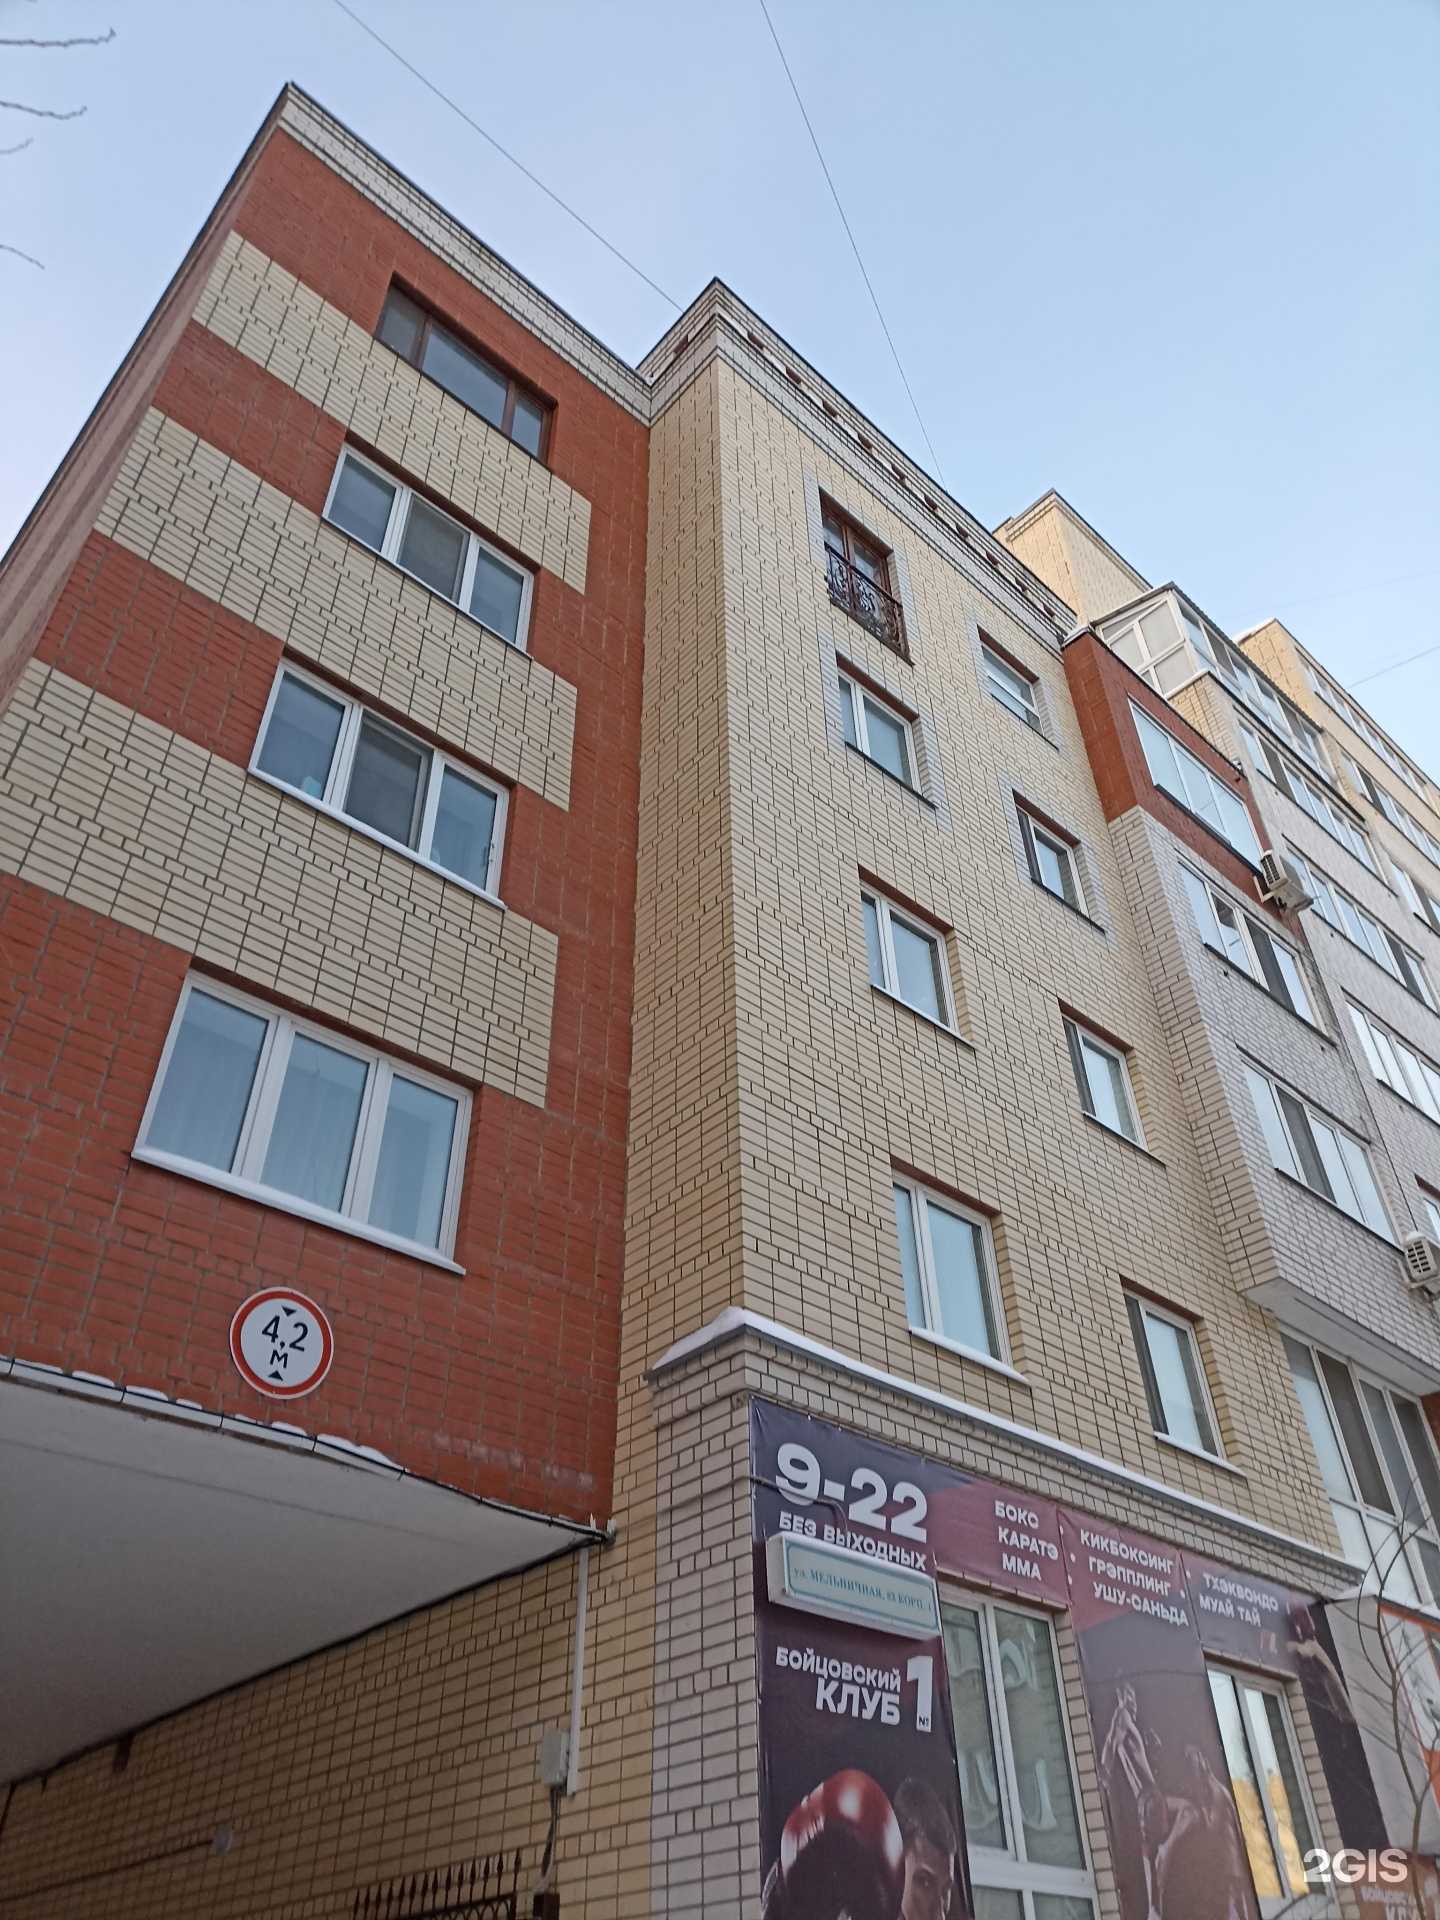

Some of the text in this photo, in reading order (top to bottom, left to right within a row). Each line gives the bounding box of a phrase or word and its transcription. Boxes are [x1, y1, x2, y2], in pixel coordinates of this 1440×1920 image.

[262, 1315, 308, 1352] 4,2
[776, 1442, 927, 1543] 9-22
[995, 1500, 1039, 1529] БОКС
[778, 1511, 927, 1571] БЕЗ ВЫХОДНЫХ
[998, 1526, 1058, 1560] КАРАТЭ
[1080, 1528, 1174, 1574] КИКБОКСИНГ
[1002, 1552, 1041, 1581] ММА
[1088, 1556, 1171, 1597] ГРЭППЛИНГ
[1093, 1581, 1189, 1627] УШУ-САНЬДА
[1199, 1593, 1261, 1627] МУАЙ ТАЙ
[1203, 1573, 1279, 1612] ТХЭКВОНДО
[775, 1646, 901, 1693] БОЙЦОВСКИЙ
[815, 1655, 933, 1732] КЛУБ 1
